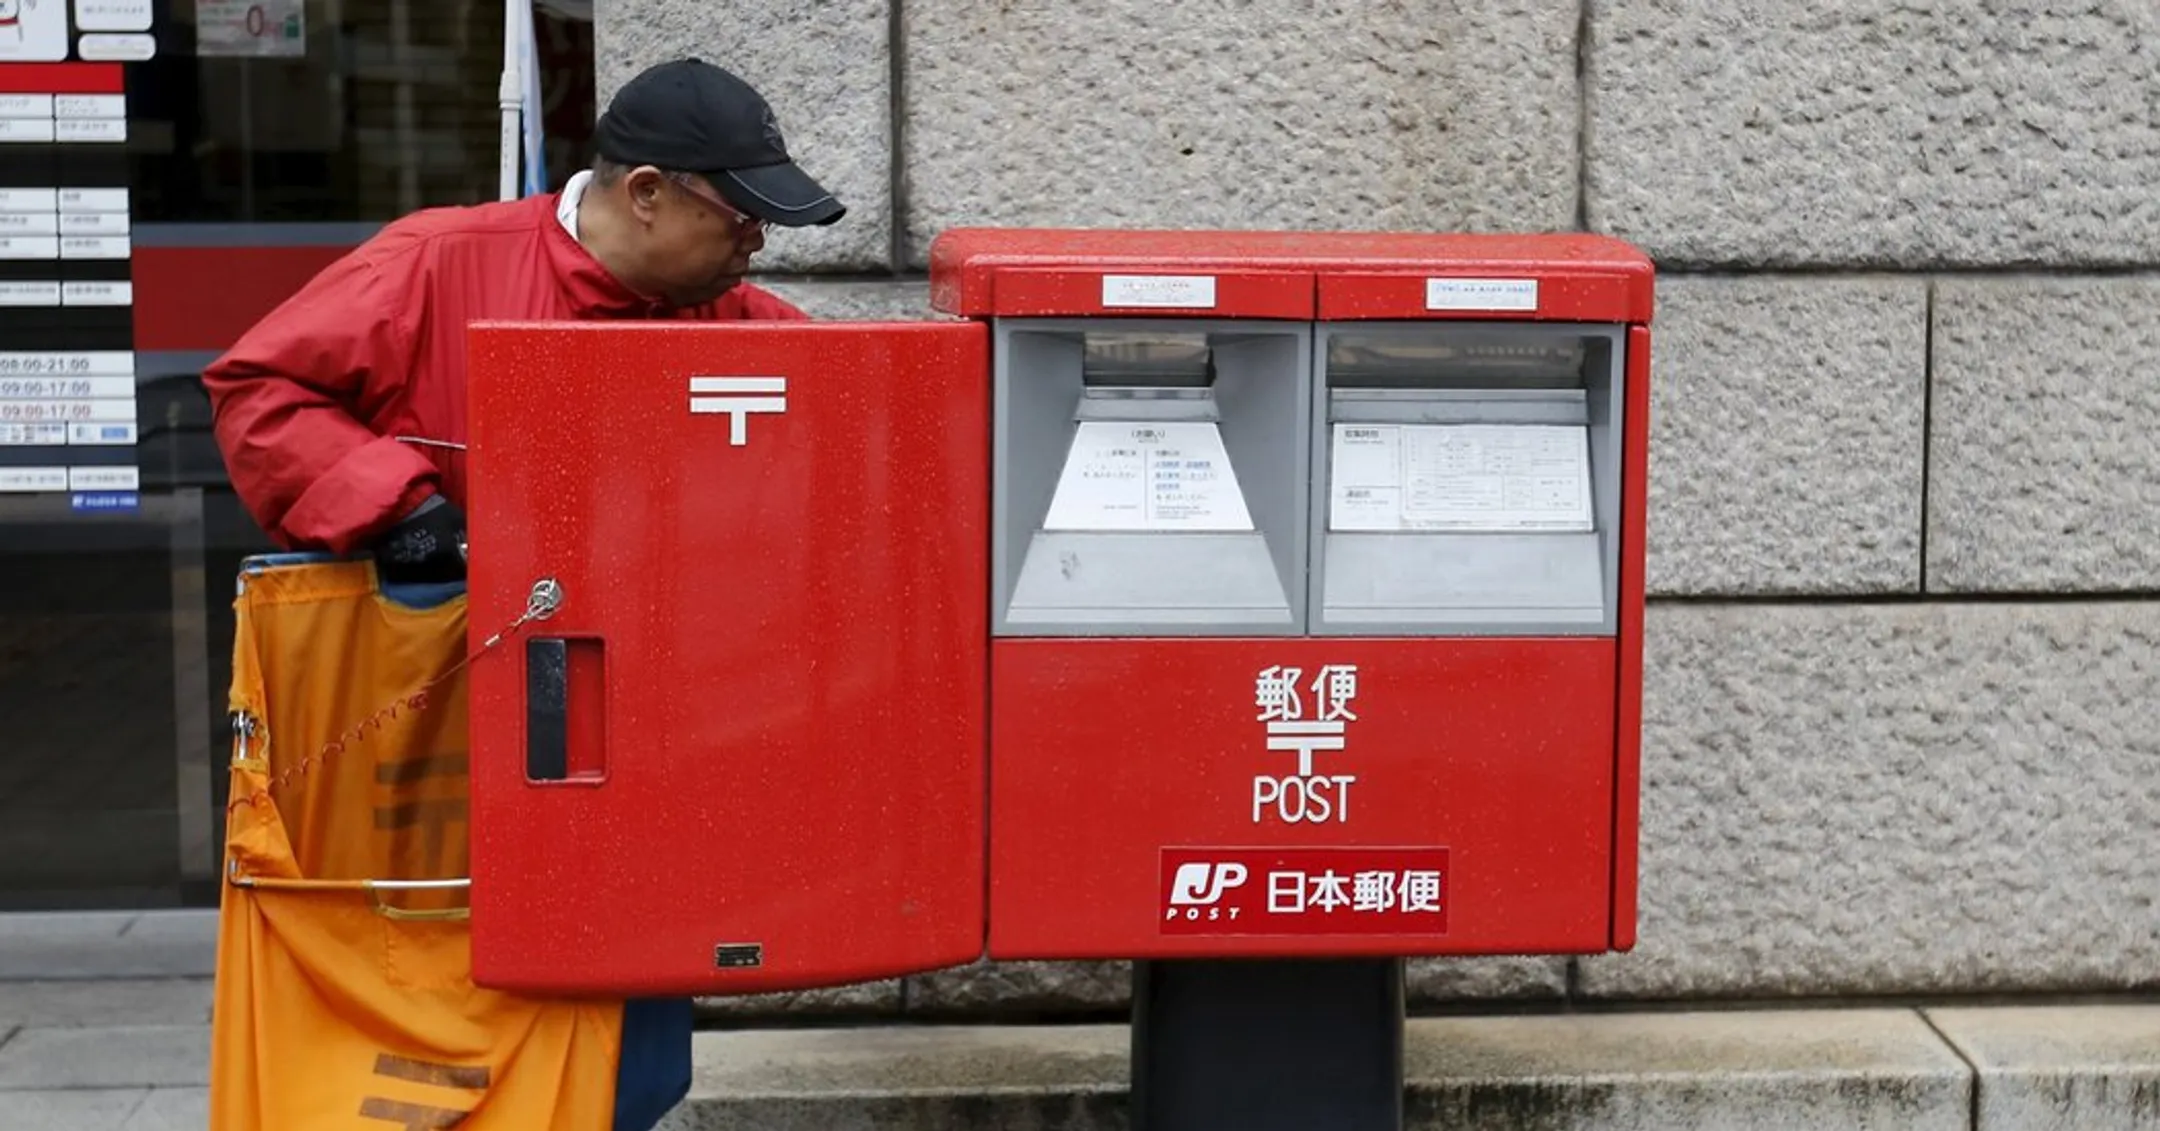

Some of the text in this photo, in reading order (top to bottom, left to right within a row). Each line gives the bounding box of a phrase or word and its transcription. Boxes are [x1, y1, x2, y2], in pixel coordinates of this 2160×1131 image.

[1255, 665, 1357, 721] 郵便
[1253, 775, 1356, 823] POST
[1170, 863, 1248, 904] JP
[1267, 869, 1441, 913] 日本郵便
[1166, 907, 1240, 920] POST
